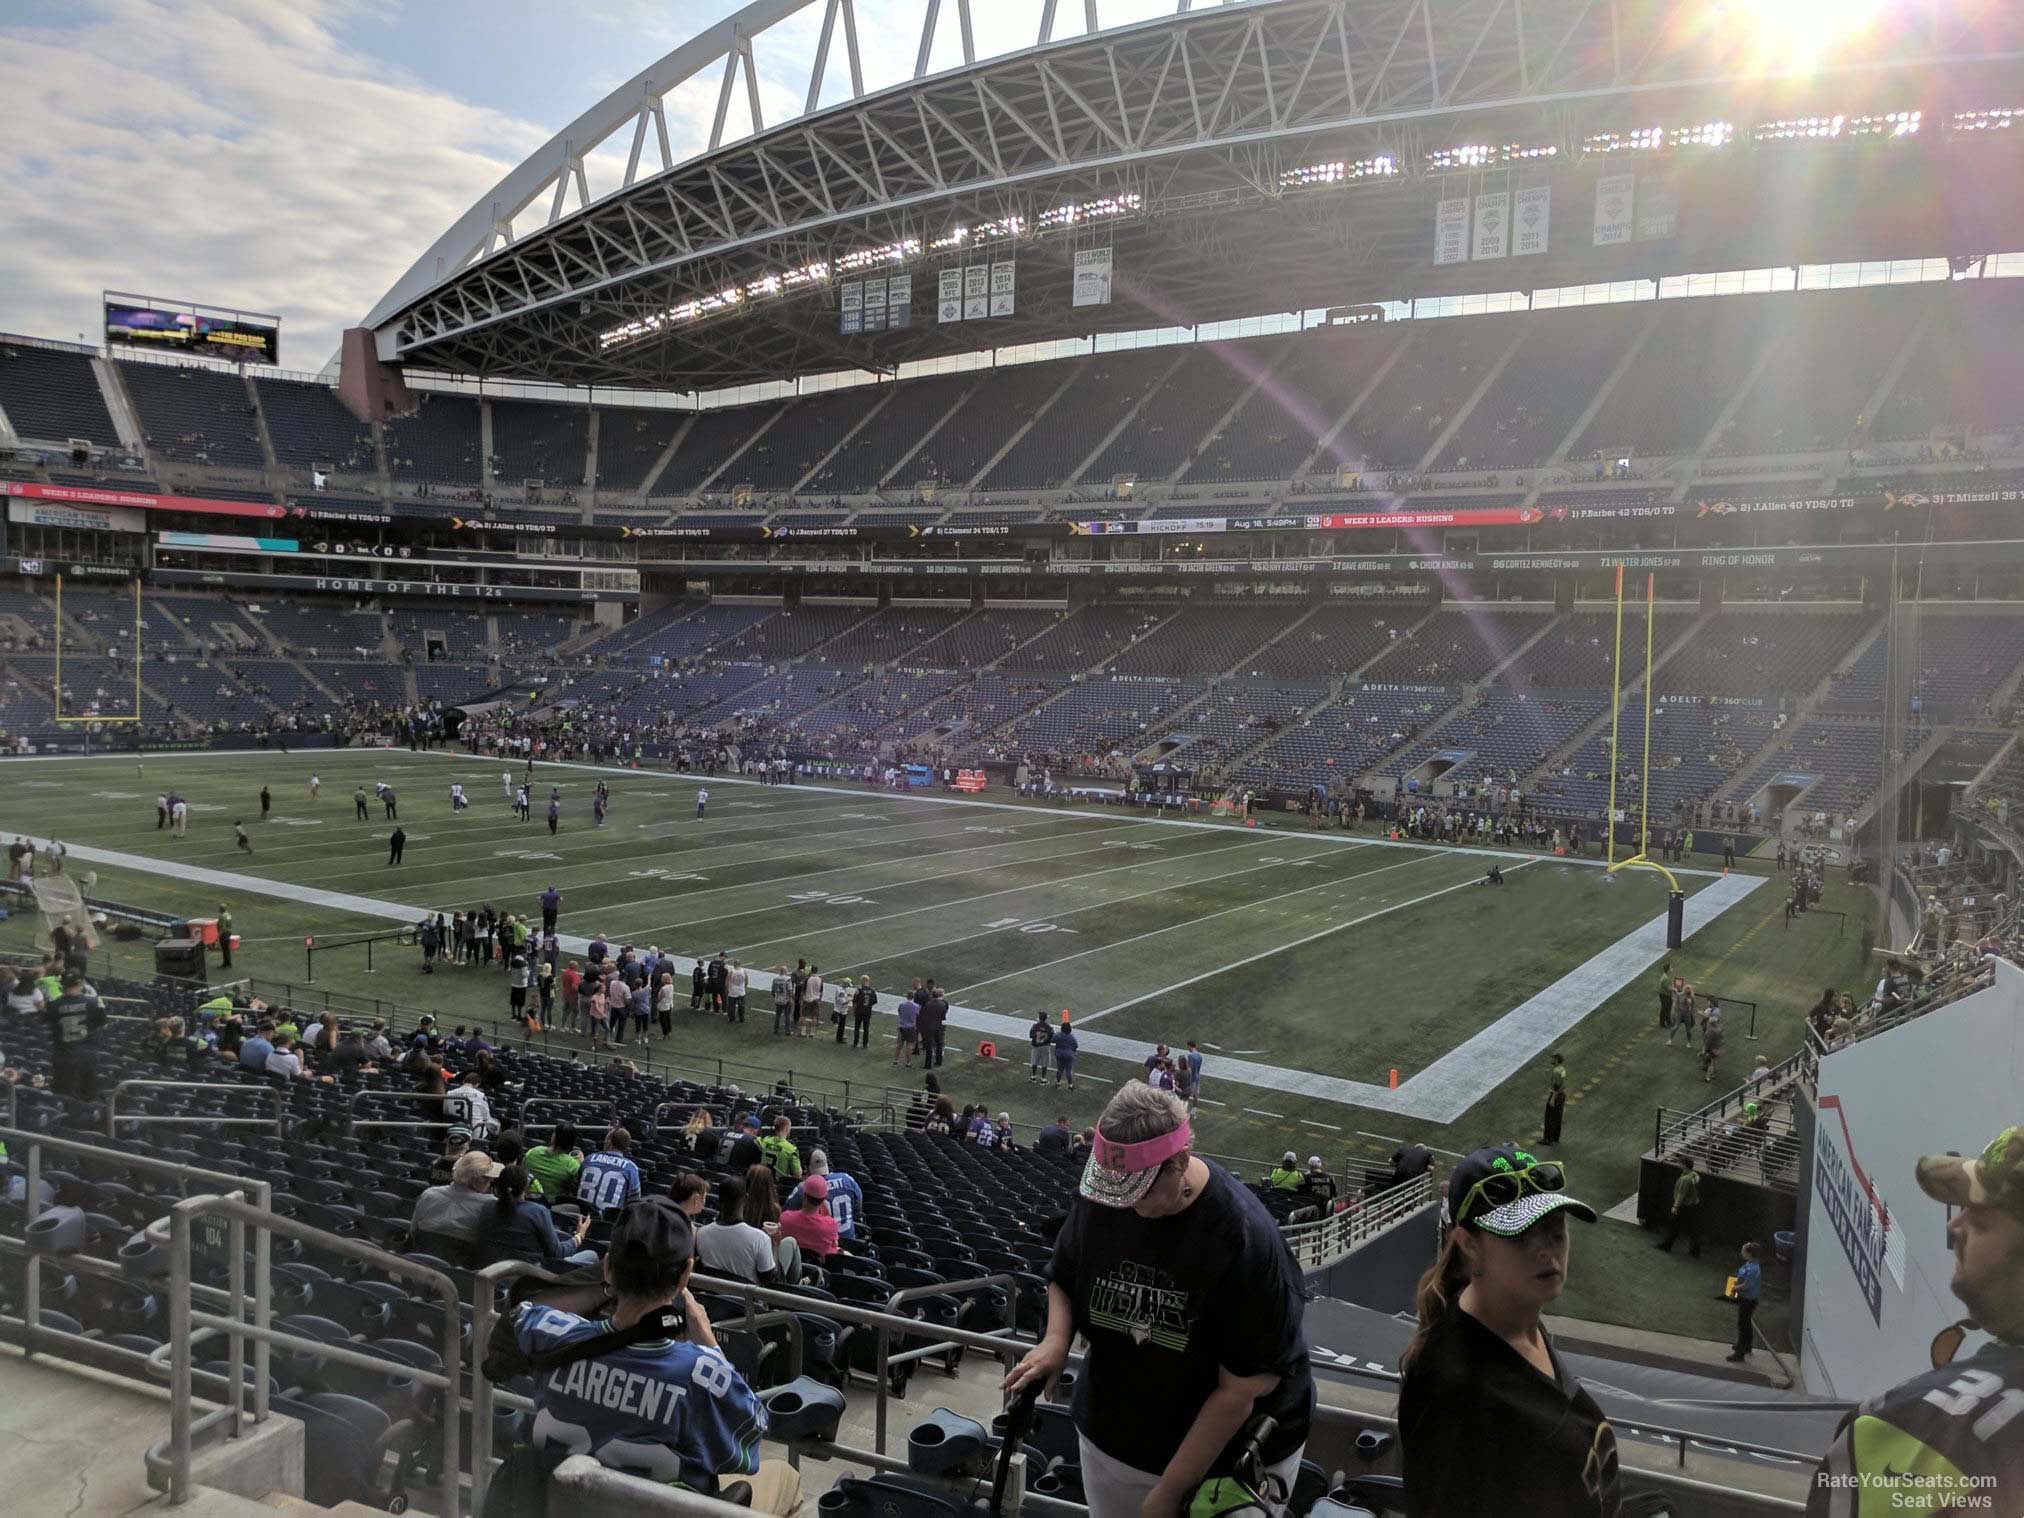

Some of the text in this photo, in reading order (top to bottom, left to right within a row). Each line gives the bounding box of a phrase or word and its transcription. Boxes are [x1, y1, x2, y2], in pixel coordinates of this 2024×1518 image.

[1662, 506, 1675, 515] TD
[1753, 502, 1786, 511] J.Allen
[1789, 501, 1803, 510] 40
[1840, 498, 1854, 508] TD
[1234, 520, 1250, 529] Aug
[1344, 517, 1368, 525] WEEK
[1416, 514, 1453, 523] RUSHING
[1702, 554, 1775, 566] RING OF HONOR
[316, 579, 502, 597] HOME OF THE 12s
[1370, 683, 1399, 691] DELTA
[1670, 695, 1704, 704] DELT
[980, 1043, 992, 1057] G
[591, 1153, 629, 1169] LARGENT
[1102, 1146, 1127, 1169] 12
[1817, 1122, 1854, 1208] AMERICAN
[577, 1166, 626, 1209] 80
[548, 1358, 687, 1424] LARGENT
